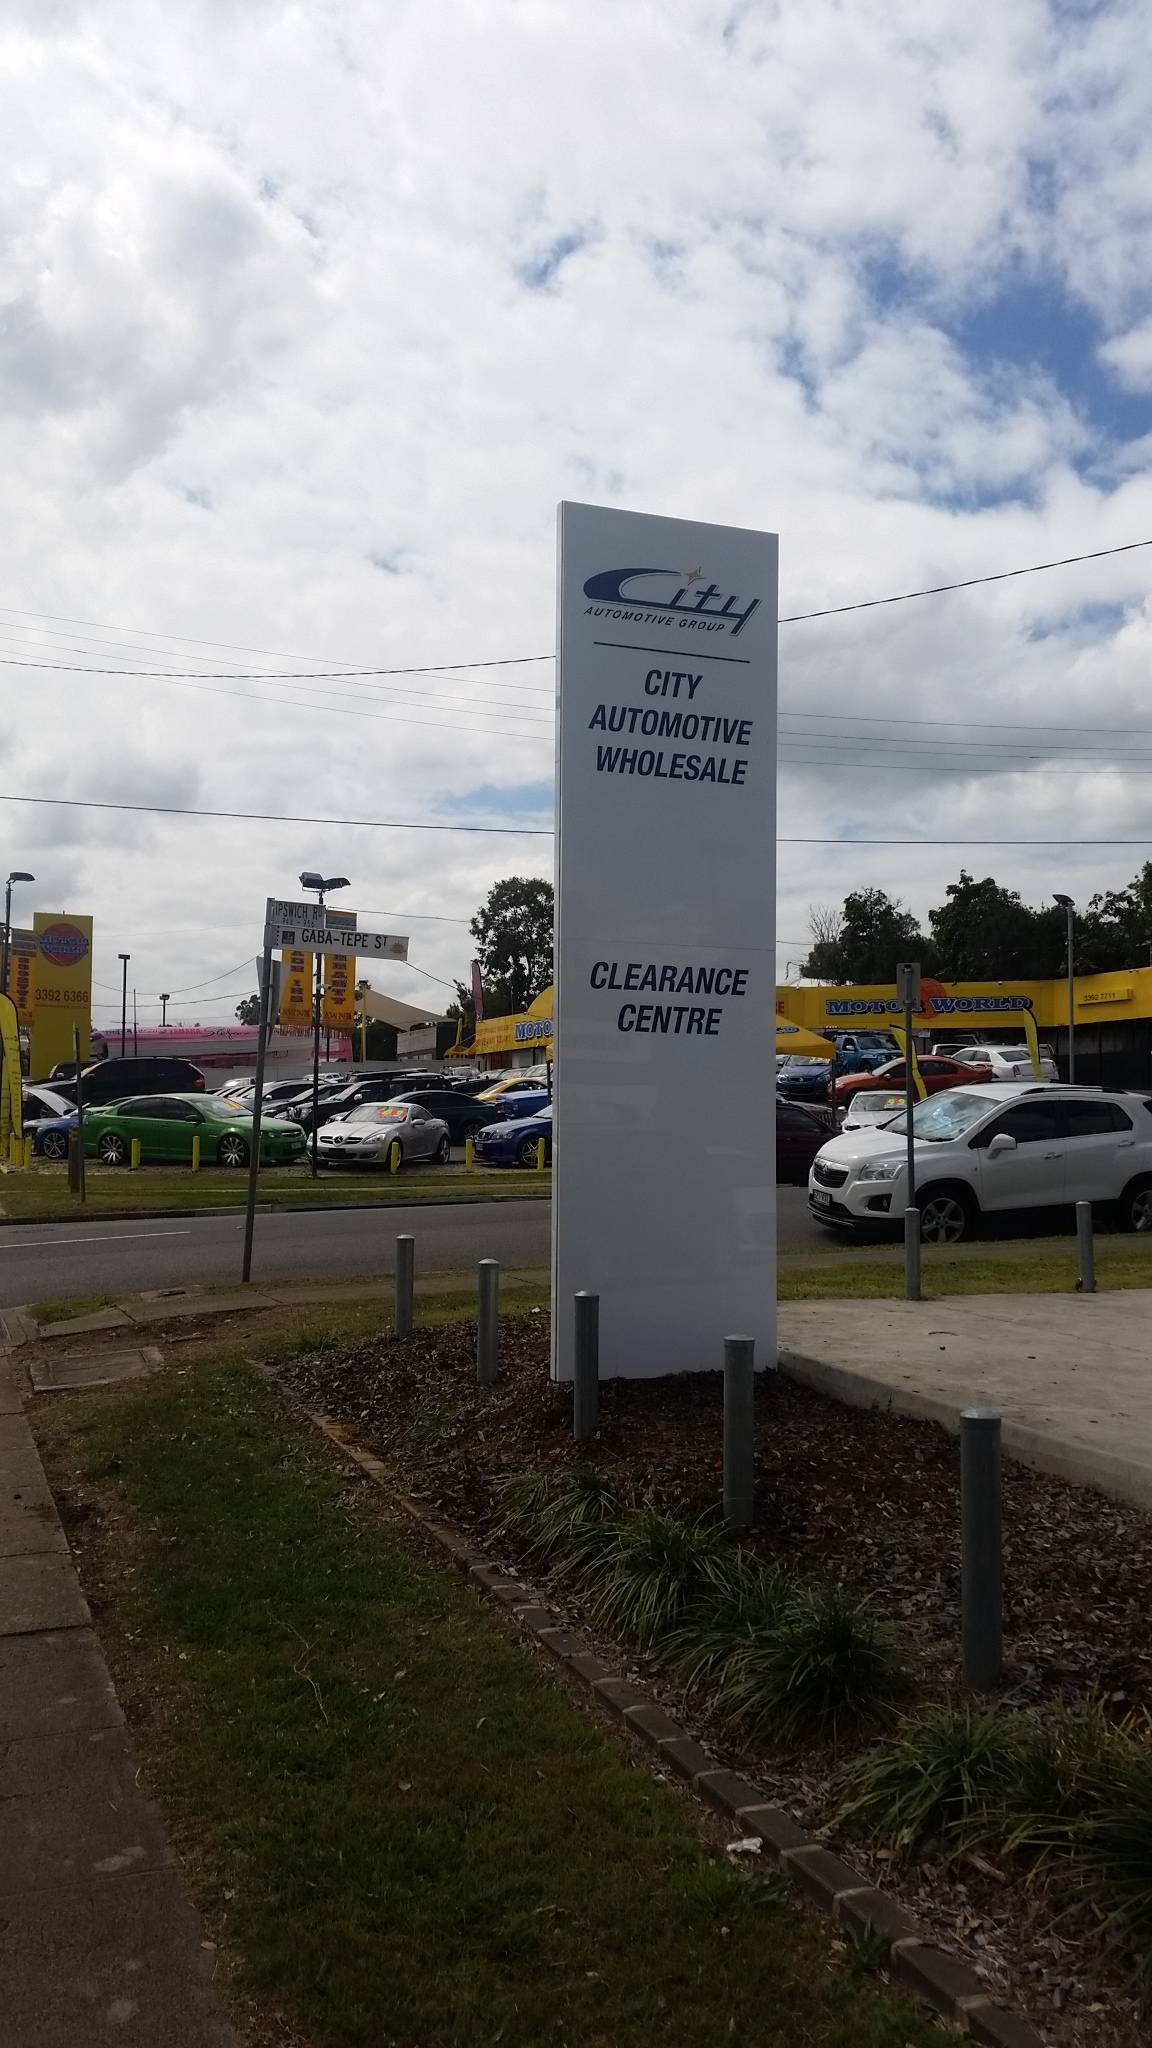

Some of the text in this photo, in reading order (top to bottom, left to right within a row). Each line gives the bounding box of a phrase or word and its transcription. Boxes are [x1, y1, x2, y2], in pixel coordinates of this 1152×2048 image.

[583, 568, 762, 636] City
[584, 606, 726, 633] AUTOMOTIVE GROUP
[644, 669, 703, 700] CITY
[588, 704, 754, 746] AUTOMOTIVE
[595, 745, 749, 785] WHOLESALE
[275, 902, 308, 919] IPSWICH
[301, 928, 369, 948] GABA-TEPE
[590, 961, 749, 996] CLEARANCE
[35, 989, 89, 1002] 3392 6366
[930, 996, 1032, 1012] WORLD
[514, 1020, 553, 1041] MOTO
[617, 1003, 723, 1036] CENTRE
